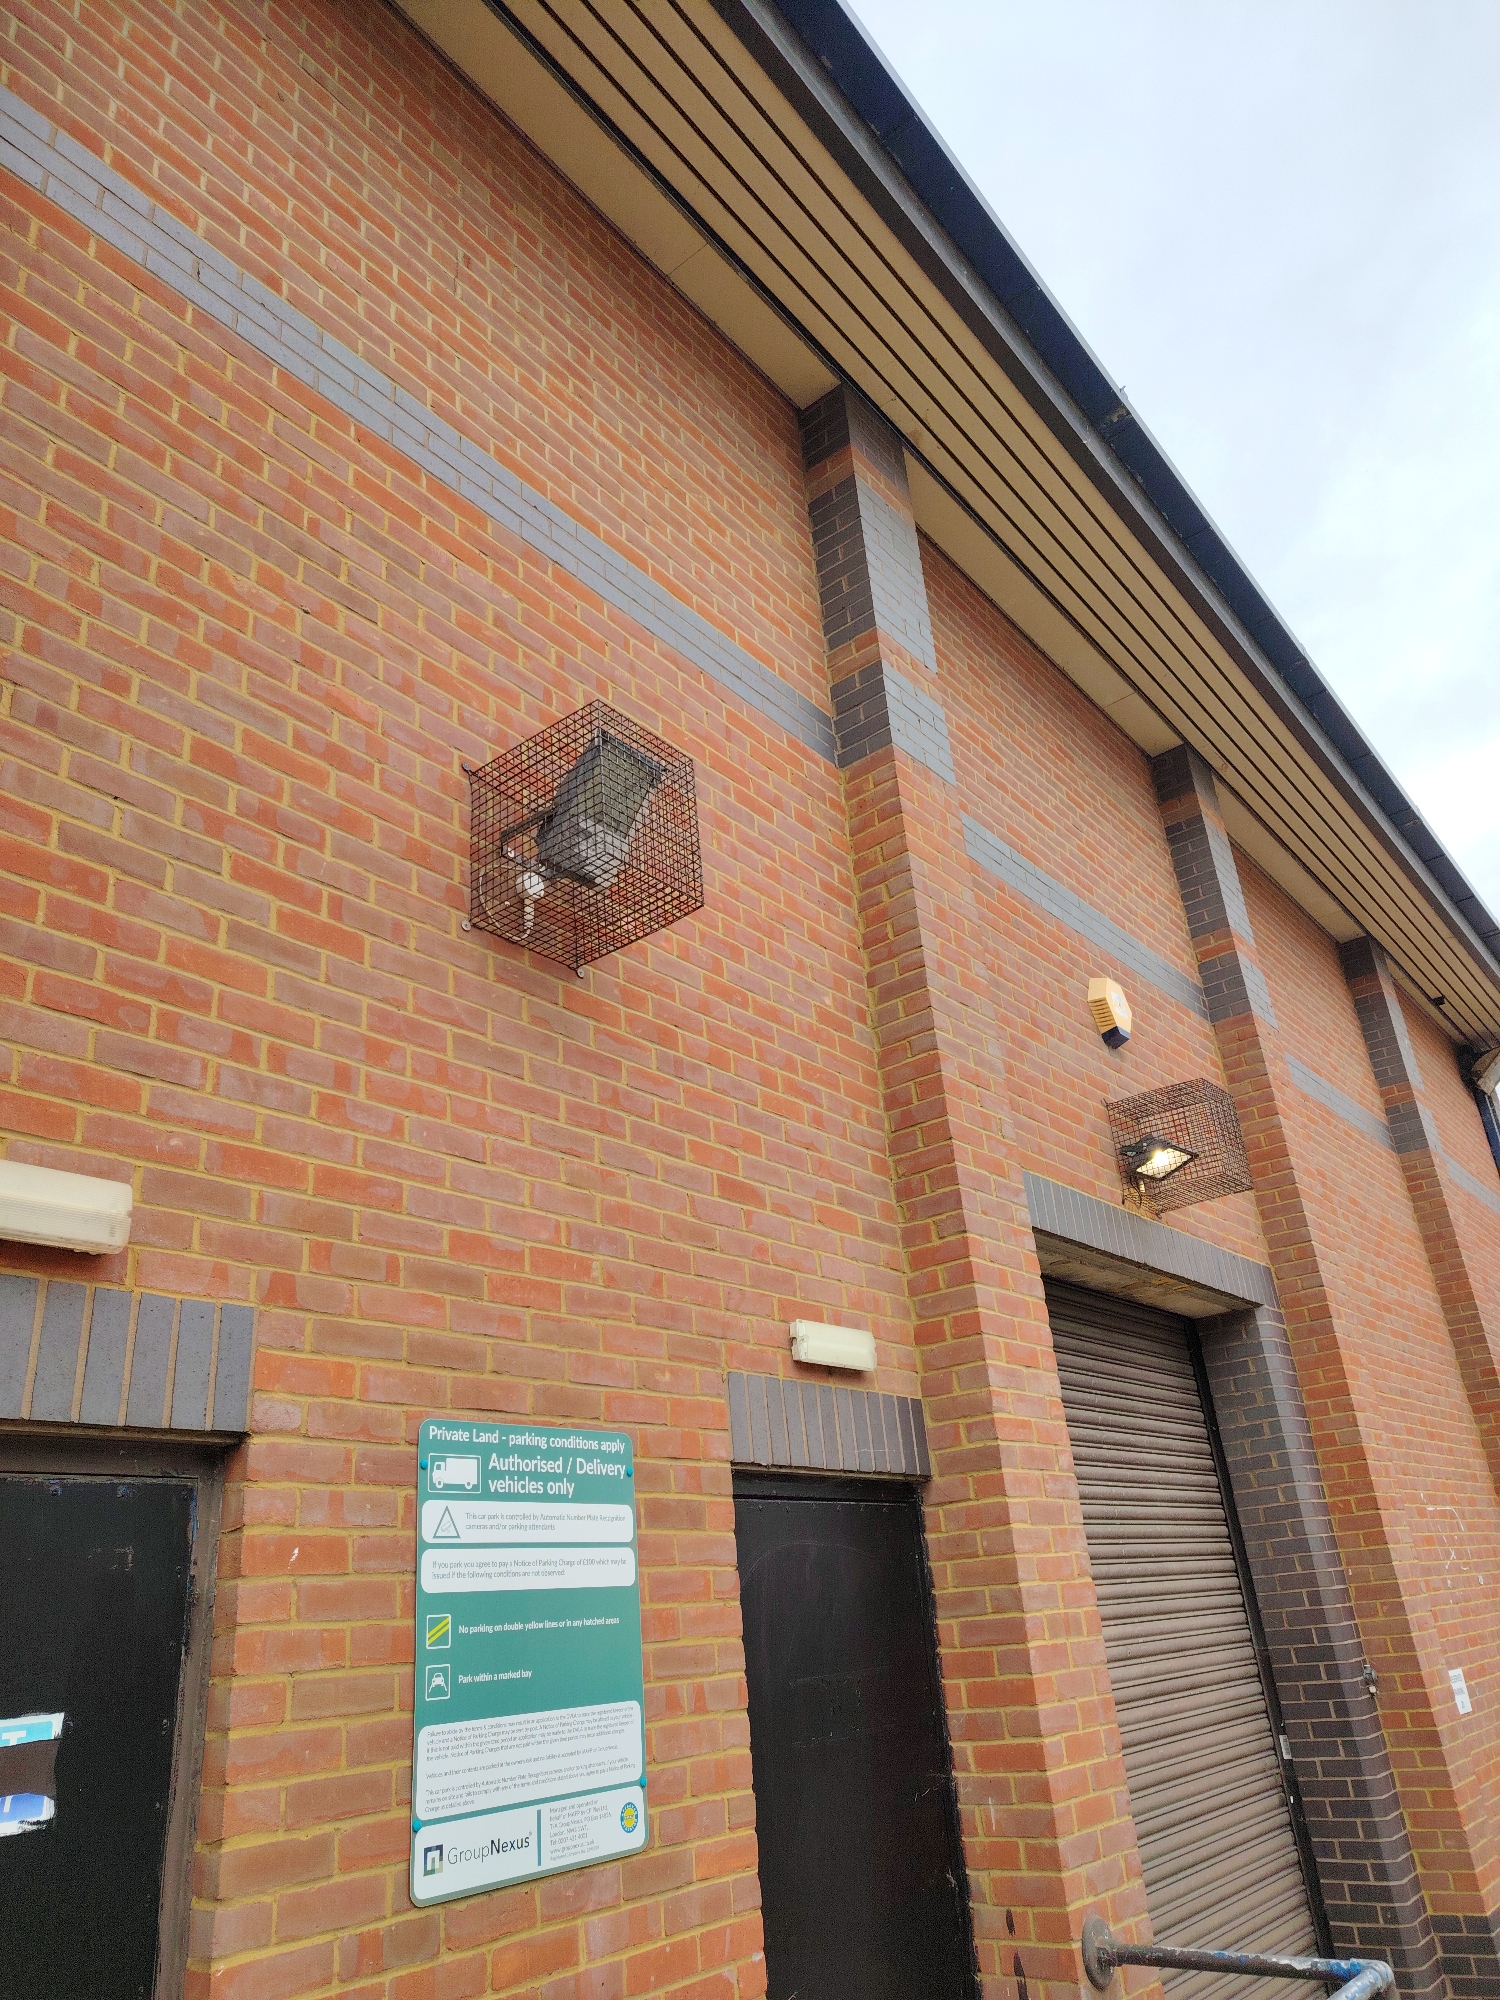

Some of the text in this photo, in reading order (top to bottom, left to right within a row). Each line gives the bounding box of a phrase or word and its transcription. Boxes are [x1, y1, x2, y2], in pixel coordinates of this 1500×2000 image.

[429, 1425, 470, 1442] Private
[472, 1428, 499, 1444] Land
[509, 1432, 548, 1449] parking
[549, 1436, 599, 1450] conditions
[600, 1439, 625, 1454] apply
[488, 1452, 626, 1480] Authorised / Delivery
[488, 1475, 574, 1498] vehicles only
[465, 1512, 477, 1520] This
[488, 1513, 499, 1521] park
[506, 1513, 531, 1521] controlled
[533, 1513, 539, 1521] by
[540, 1513, 566, 1521] Automatic
[508, 1523, 527, 1531] parking
[450, 1561, 462, 1569] park
[538, 1559, 557, 1567] Parking
[558, 1559, 575, 1567] Charge
[457, 1571, 466, 1579] the
[467, 1571, 492, 1579] following
[494, 1570, 521, 1578] conditions
[458, 1625, 469, 1634] No
[470, 1624, 493, 1634] parking
[503, 1622, 524, 1631] double
[524, 1620, 544, 1631] yellow
[544, 1620, 558, 1628] lines
[566, 1619, 571, 1627] in
[583, 1617, 605, 1626] hatched
[458, 1674, 473, 1684] Park
[474, 1672, 493, 1682] within
[499, 1669, 520, 1680] marked
[521, 1669, 533, 1679] bay
[448, 1837, 530, 1864] GroupNexus
